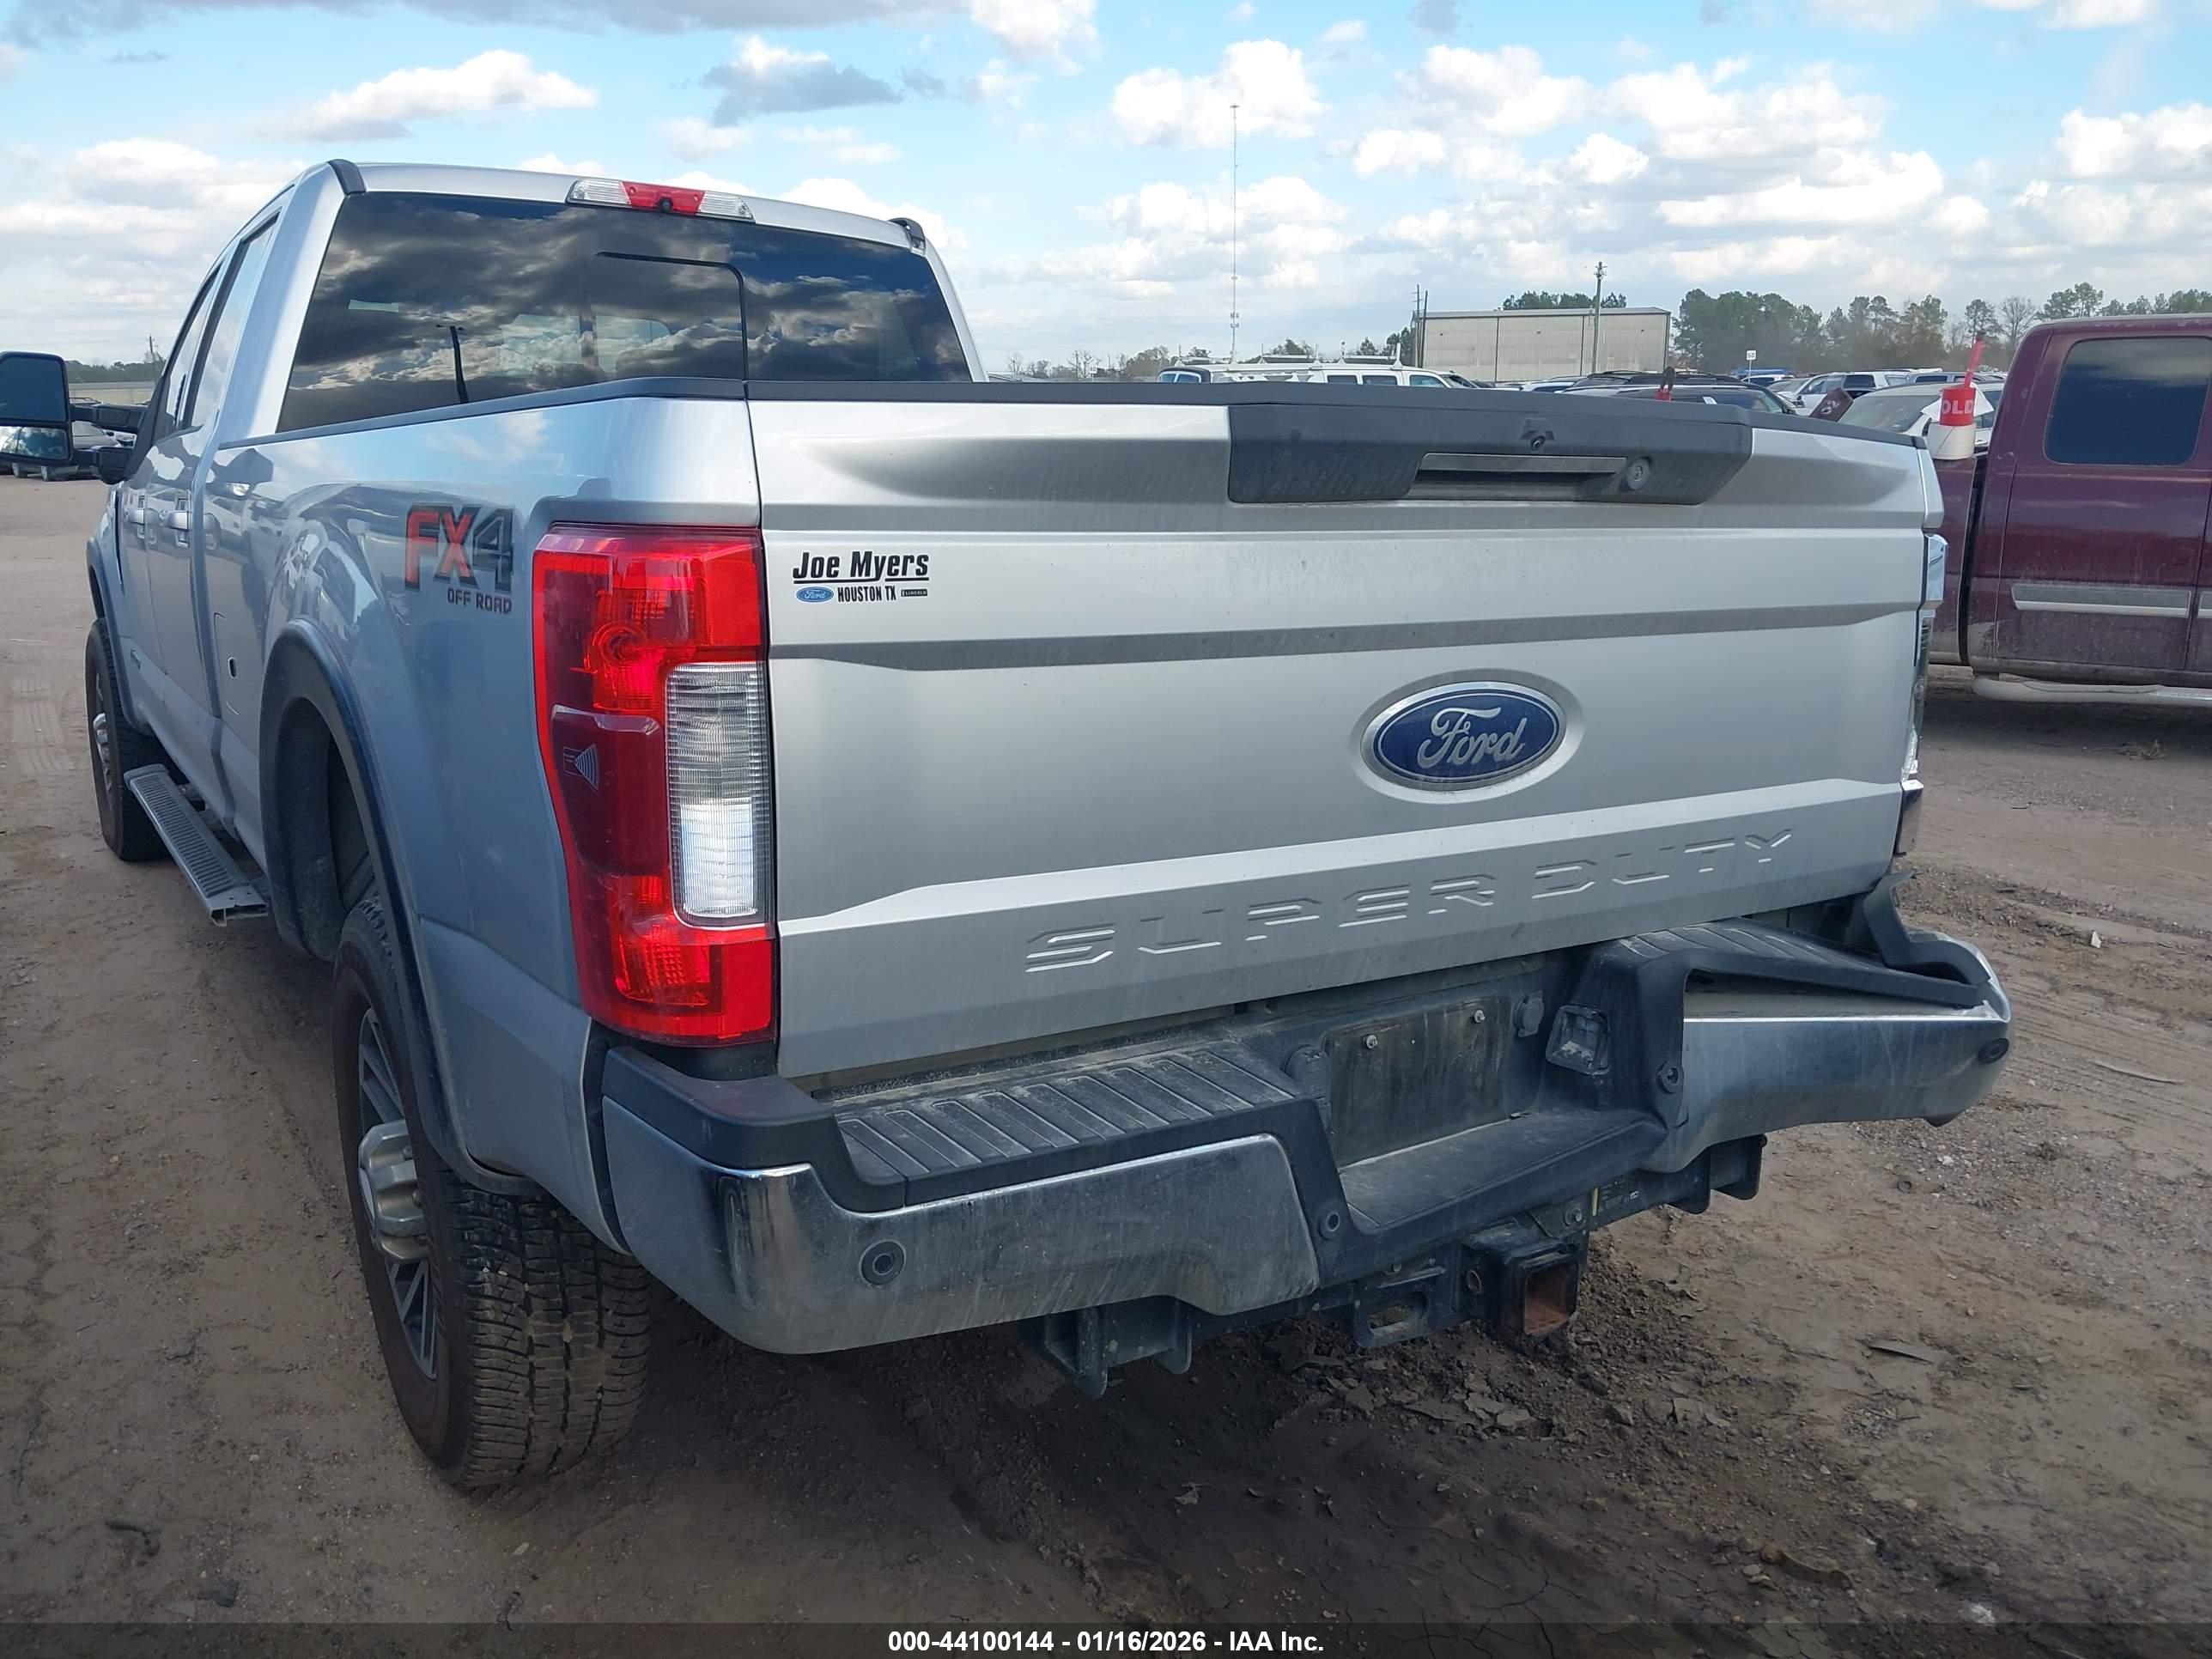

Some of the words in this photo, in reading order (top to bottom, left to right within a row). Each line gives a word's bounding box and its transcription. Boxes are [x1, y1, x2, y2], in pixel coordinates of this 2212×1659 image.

[405, 504, 514, 592] FX4
[793, 552, 840, 579] Joe
[850, 551, 929, 581] Myers
[447, 588, 471, 606] OFF
[476, 593, 513, 614] ROAD
[804, 589, 826, 599] Ford
[837, 586, 882, 603] HOUSTON
[884, 585, 896, 601] TX
[1417, 707, 1528, 769] Ford
[1025, 873, 1496, 972] SUPER
[1532, 829, 1792, 899] DUTY
